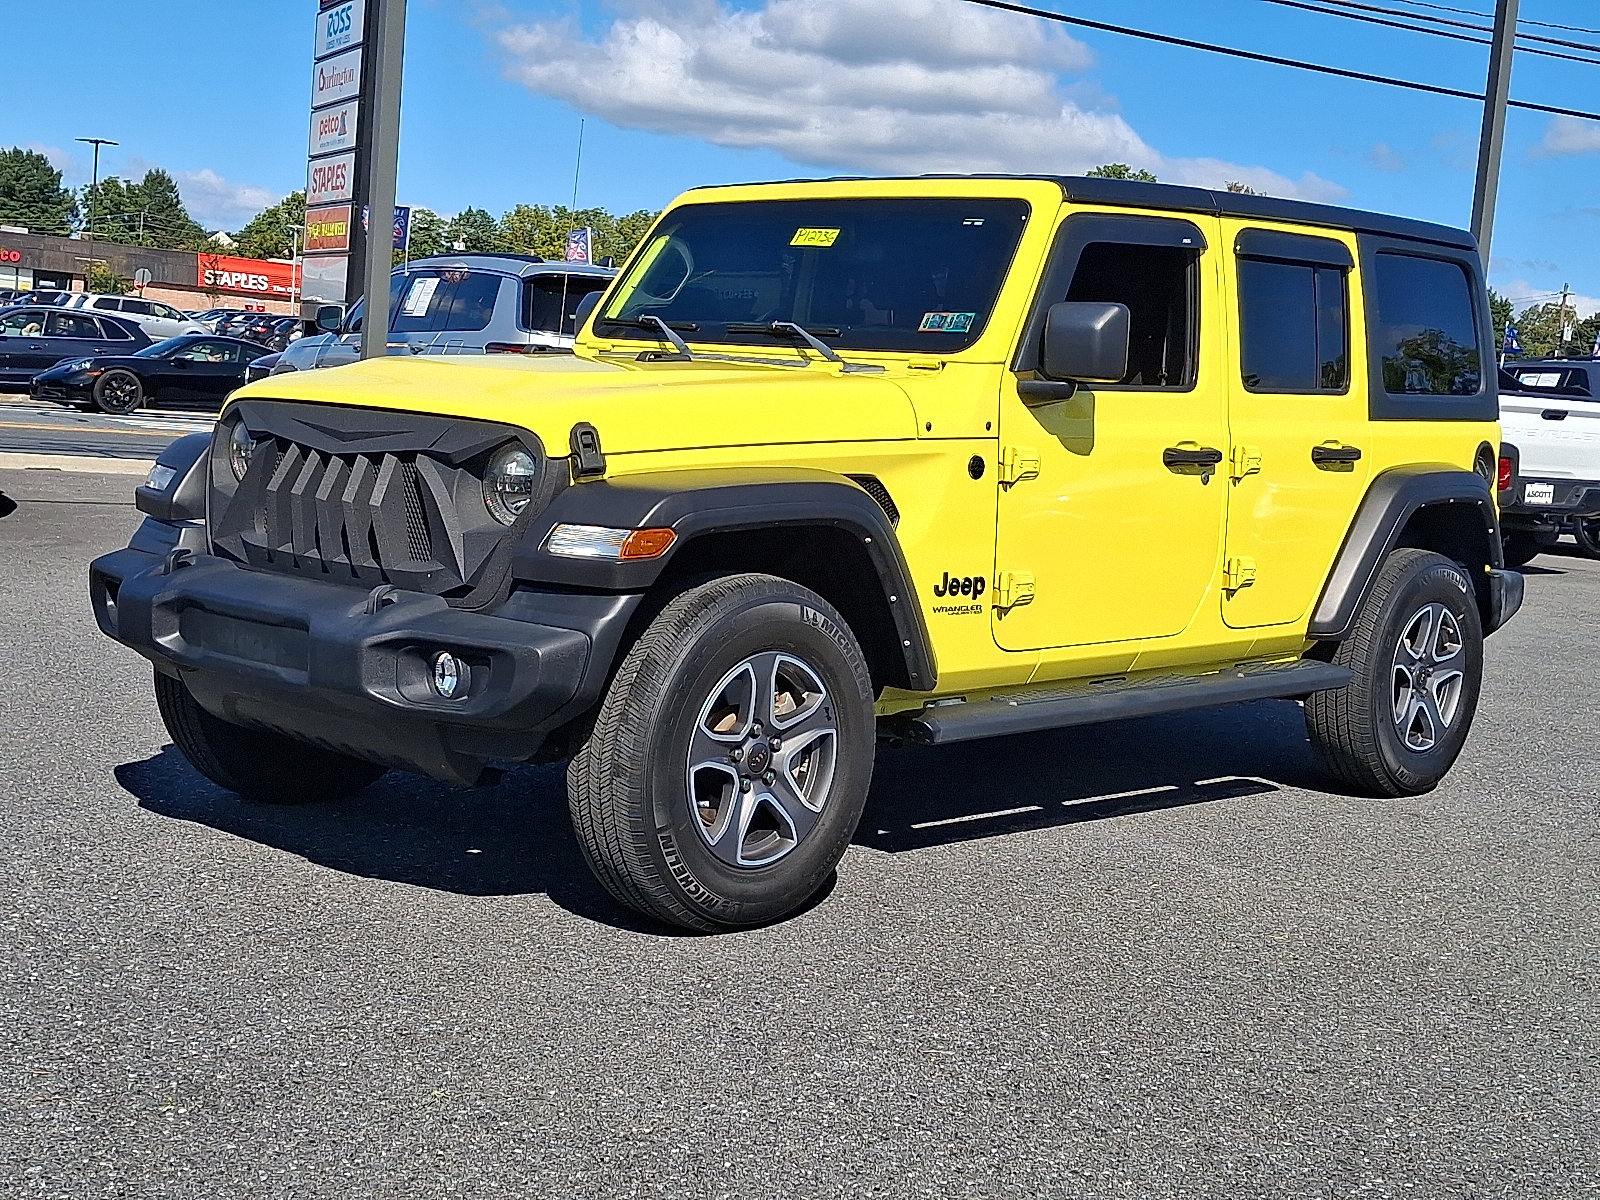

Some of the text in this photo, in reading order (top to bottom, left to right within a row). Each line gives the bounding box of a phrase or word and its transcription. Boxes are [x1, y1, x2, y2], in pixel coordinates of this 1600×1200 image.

[327, 4, 352, 38] ROSS
[318, 65, 355, 92] Burlington
[318, 115, 339, 141] petco
[312, 163, 347, 194] STAPLES
[204, 269, 269, 291] STAPLES
[934, 571, 986, 600] Jeep
[933, 604, 982, 613] WRANGLER
[659, 834, 721, 910] MICHELIN
